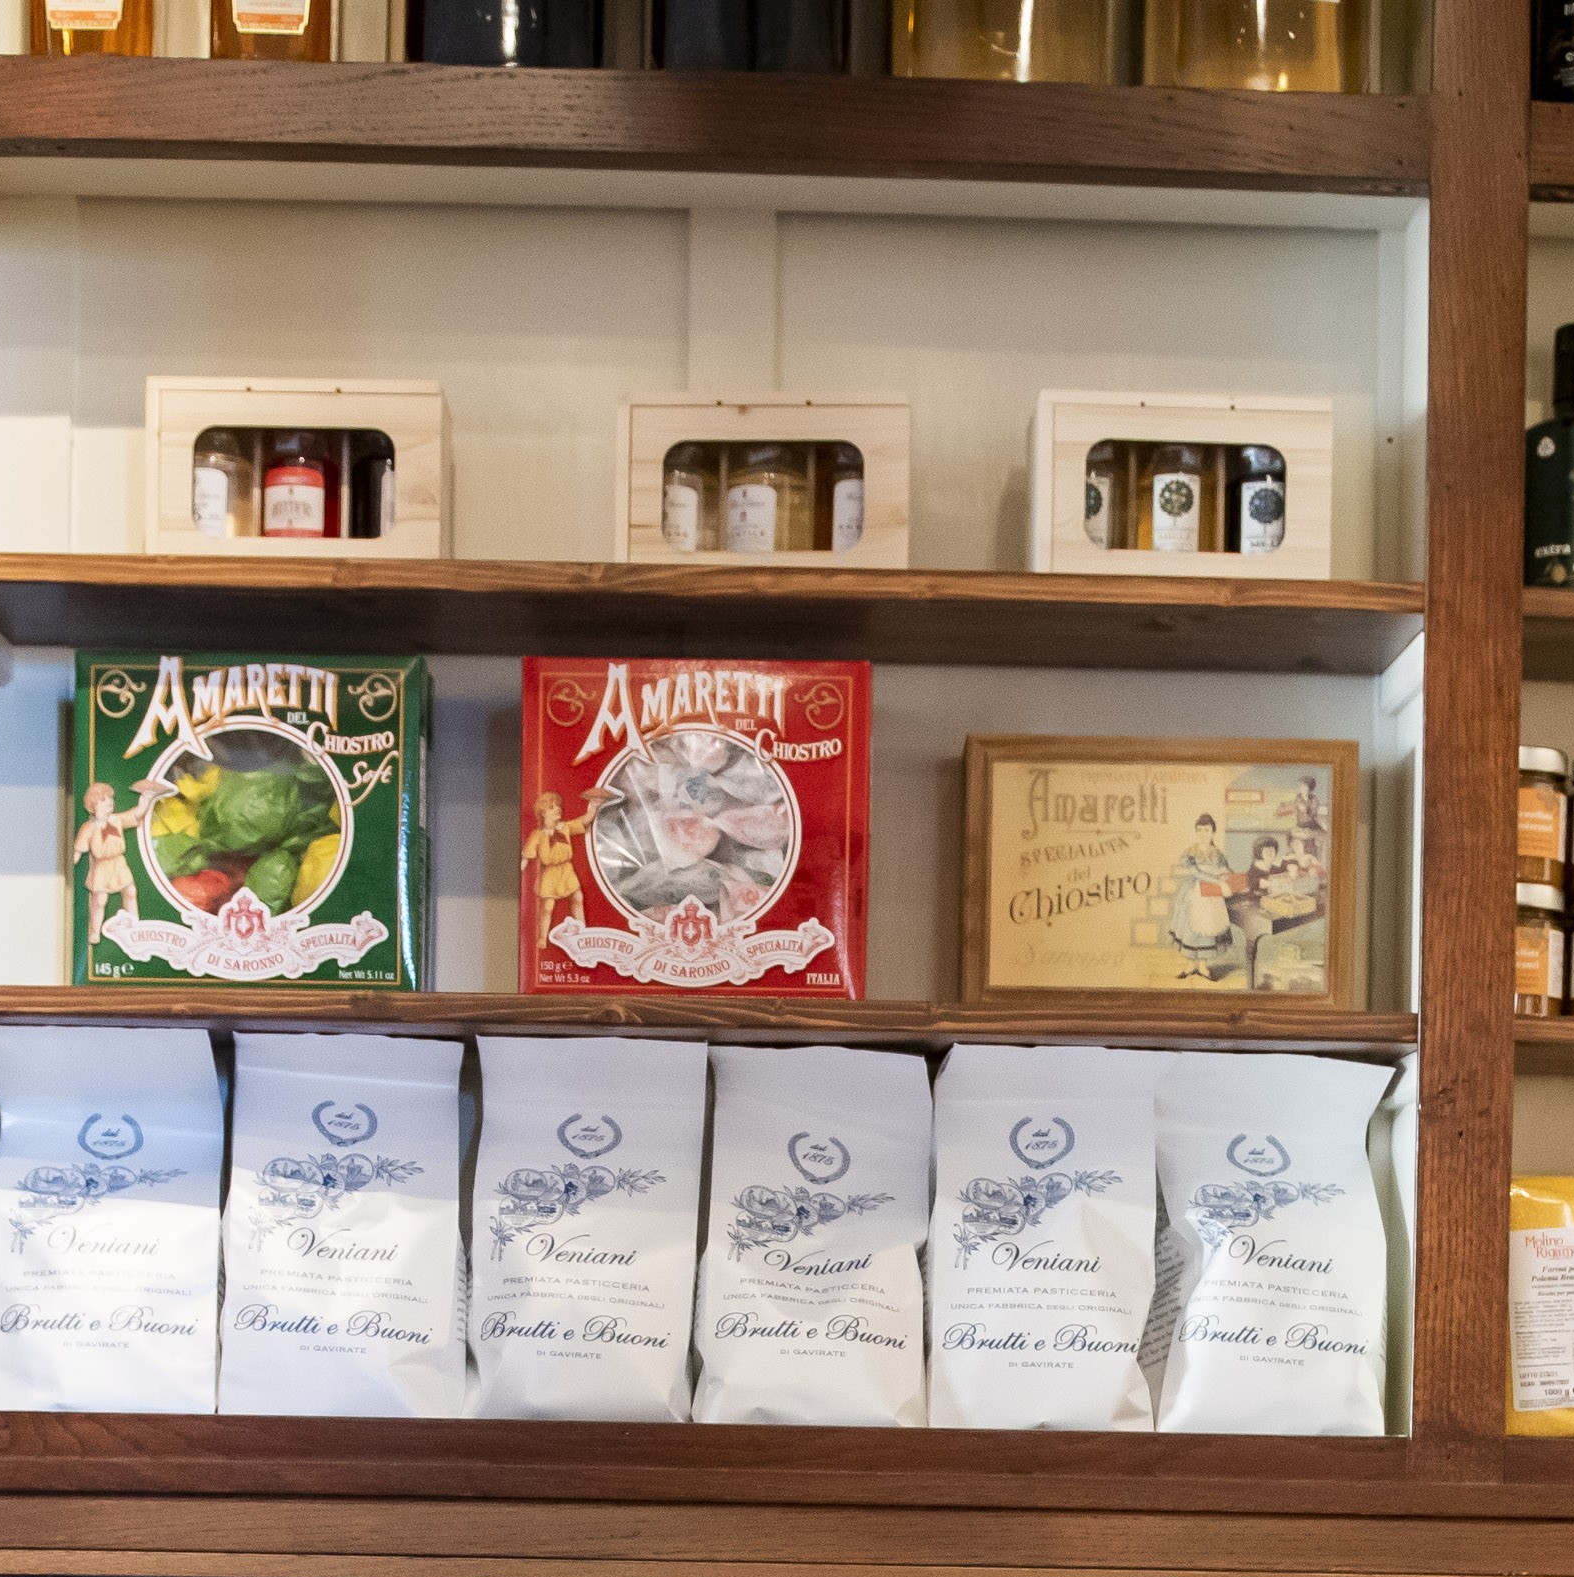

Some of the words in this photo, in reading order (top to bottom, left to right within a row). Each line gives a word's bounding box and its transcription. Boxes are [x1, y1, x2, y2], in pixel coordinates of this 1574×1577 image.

[123, 656, 338, 760] AMARETTI
[288, 712, 309, 723] DEL
[573, 663, 785, 765] AMARETTI
[735, 718, 757, 731] DEL
[307, 721, 394, 754] CHIOSTRO
[754, 728, 842, 762] CHIOSTRO
[344, 751, 398, 806] Soft
[1021, 768, 1168, 840] Amaretti
[1010, 871, 1151, 927] Chiostro
[130, 932, 187, 947] CHIOSTRO
[578, 937, 634, 955] CHIOSTRO
[208, 952, 220, 965] DI
[224, 951, 284, 971] SARONNO
[653, 960, 666, 971] DI
[669, 959, 730, 977] SARONNO
[807, 973, 840, 984] ITALIA
[803, 1151, 835, 1165] 1875
[288, 1227, 399, 1262] Veniani
[526, 1233, 637, 1267] Veniani
[992, 1240, 1102, 1273] Veniani
[1228, 1235, 1333, 1275] Veniani
[1525, 1235, 1564, 1248] Molino
[765, 1249, 872, 1276] Veniani
[235, 1304, 322, 1335] Brutti
[327, 1324, 338, 1335] e
[346, 1310, 432, 1345] Buoni
